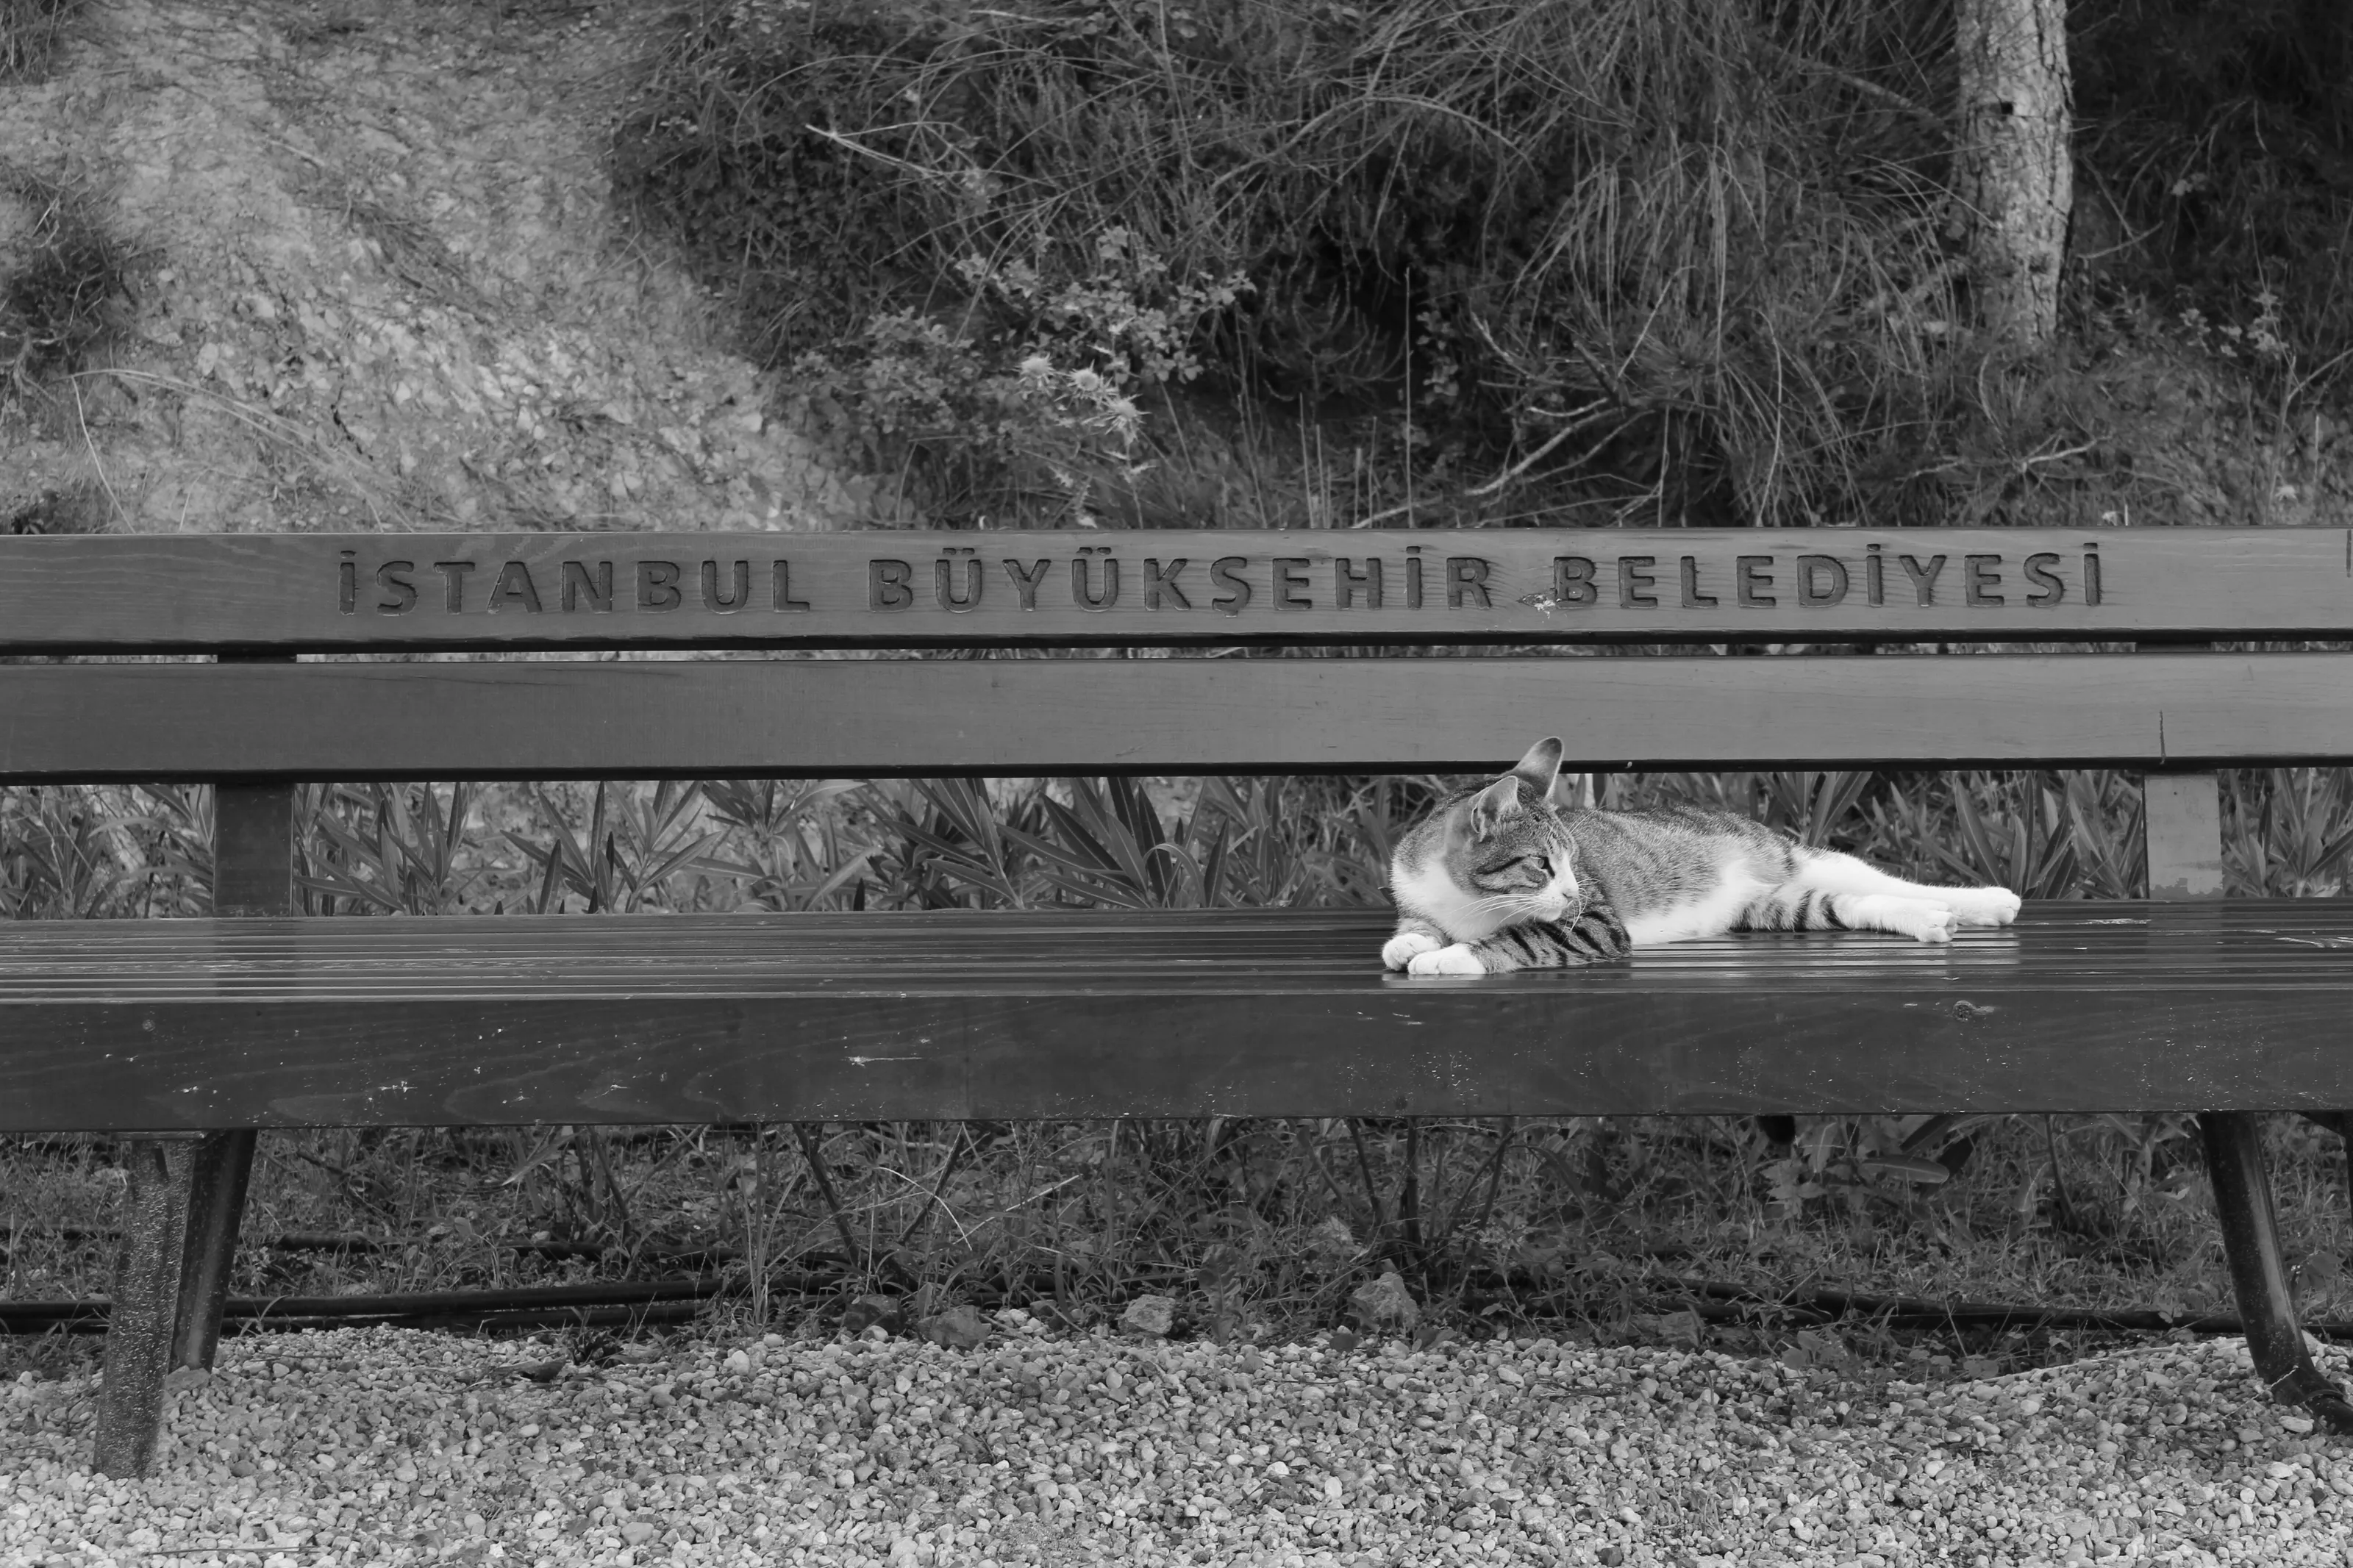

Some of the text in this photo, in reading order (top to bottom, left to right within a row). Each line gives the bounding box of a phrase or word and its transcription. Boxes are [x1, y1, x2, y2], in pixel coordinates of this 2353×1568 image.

[338, 543, 2102, 617] İSTANBUL BÜYÜKŞEHİR BELEDİYESİ
